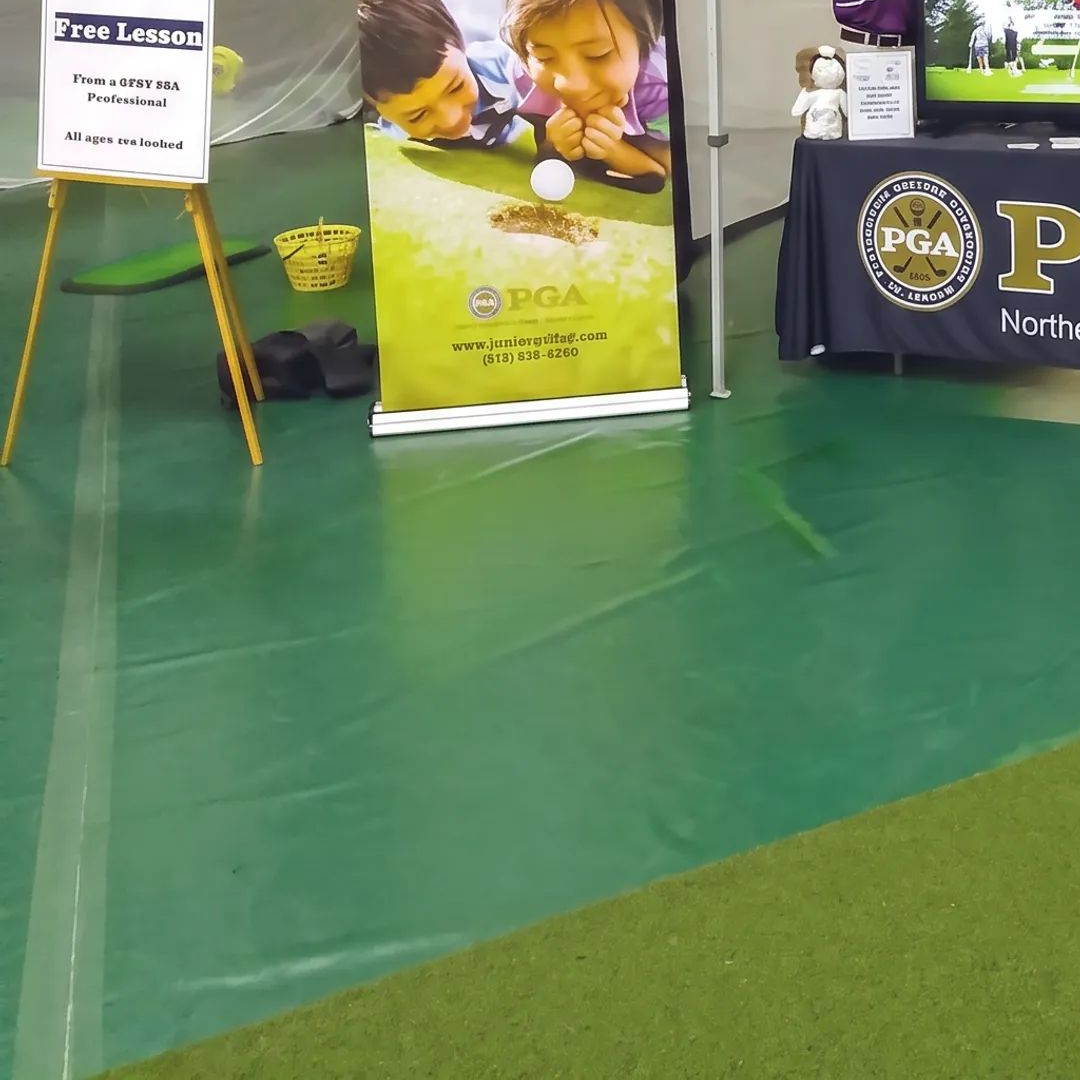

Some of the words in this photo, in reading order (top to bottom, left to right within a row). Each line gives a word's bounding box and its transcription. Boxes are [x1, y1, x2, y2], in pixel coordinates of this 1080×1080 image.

[54, 17, 111, 41] Free
[116, 22, 203, 48] Lesson
[72, 73, 106, 86] From
[109, 79, 117, 87] a
[64, 131, 82, 141] All
[85, 133, 113, 145] ages
[880, 226, 960, 258] PGA
[507, 284, 588, 312] PGA
